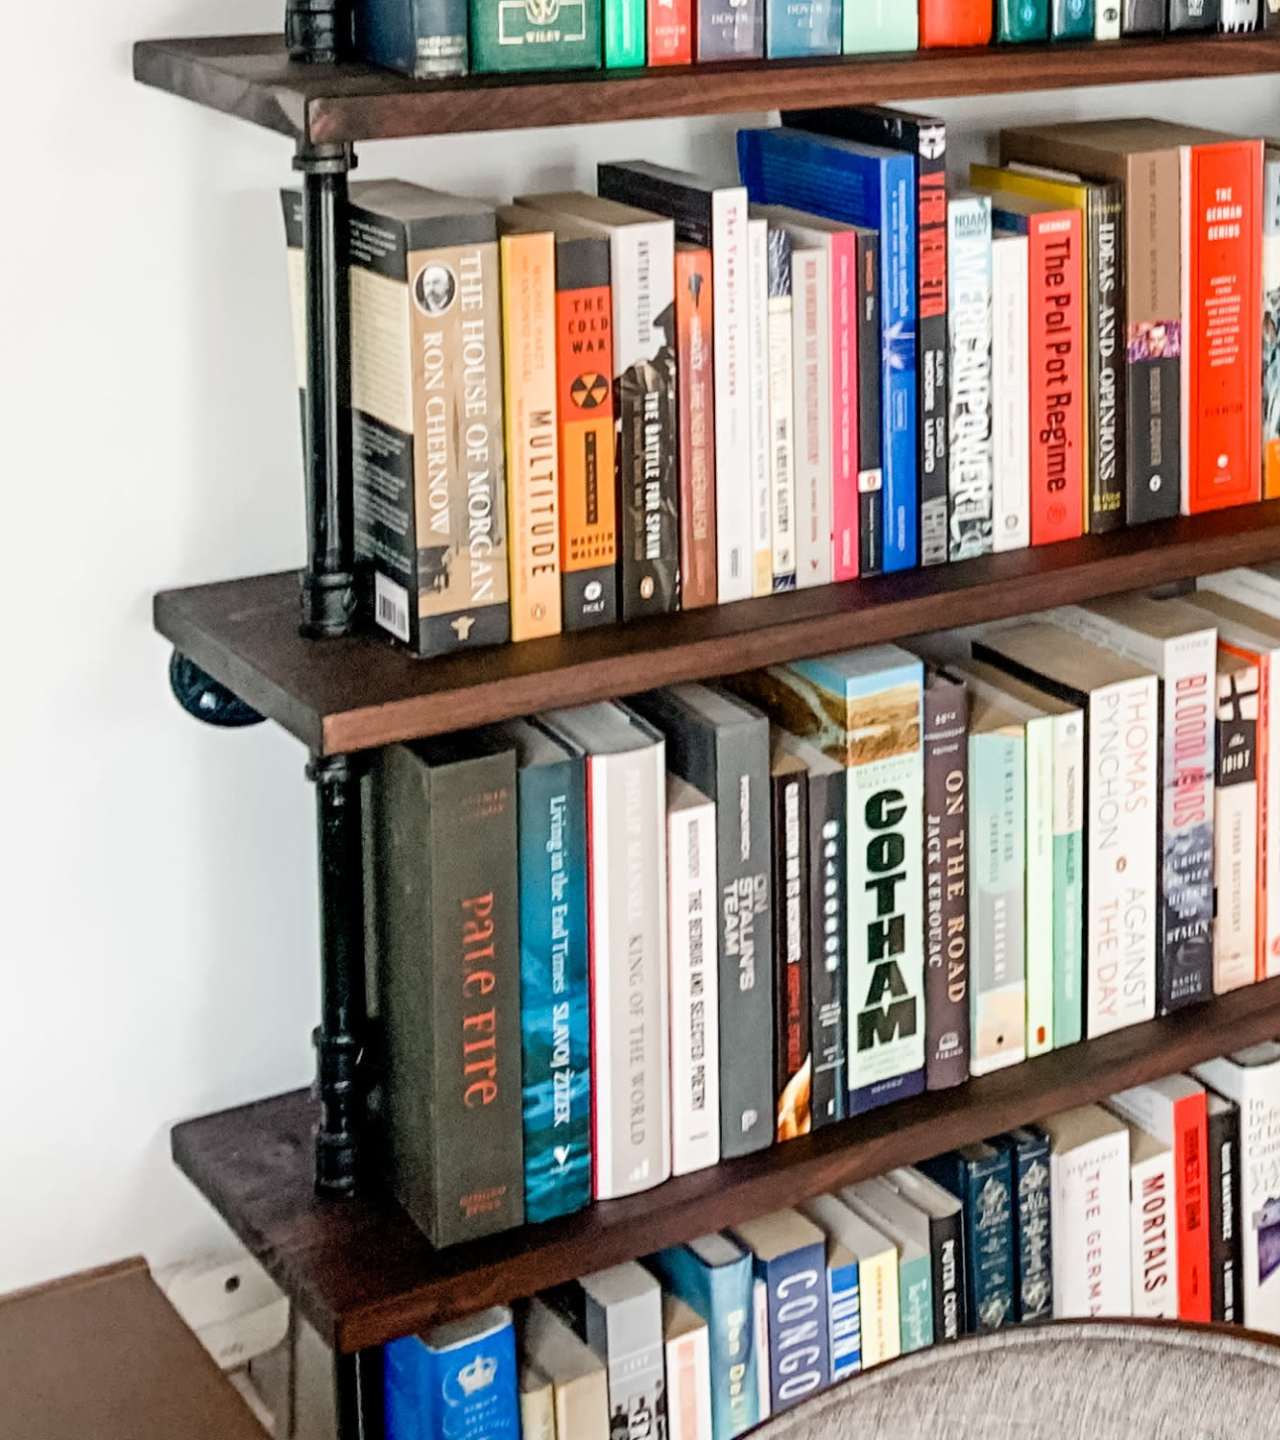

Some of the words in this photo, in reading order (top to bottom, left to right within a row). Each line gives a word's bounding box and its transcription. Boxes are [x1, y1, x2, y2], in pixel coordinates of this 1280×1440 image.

[525, 28, 562, 44] WILEY
[953, 213, 988, 227] NOAM
[1205, 204, 1244, 223] GERMAN
[1215, 186, 1233, 201] THE
[1098, 221, 1115, 294] IDEAS
[1207, 223, 1241, 241] GENIUS
[459, 251, 482, 313] THE
[1044, 238, 1072, 287] The
[567, 318, 611, 335] COLD
[571, 299, 604, 314] THE
[1044, 294, 1072, 335] Pol
[1098, 304, 1116, 357] AND
[423, 332, 446, 388] RON
[461, 319, 487, 419] HOUSE
[571, 338, 607, 353] WAR
[1044, 342, 1072, 388] Pot
[643, 391, 659, 422] THE
[1099, 366, 1117, 481] OPINIONS
[425, 397, 451, 535] CHERNOW
[465, 424, 488, 462] OF
[643, 425, 661, 478] BATTLE
[1041, 395, 1073, 493] Regime
[527, 410, 555, 579] MULTITUDE
[644, 482, 660, 509] FOR
[466, 471, 494, 603] MORGAN
[644, 512, 662, 560] SPAIN
[1098, 691, 1122, 855] PYNCHON
[1124, 686, 1150, 816] THOMAS
[1171, 672, 1208, 831] BLOODLANDS
[1221, 752, 1251, 776] IDIOT
[945, 770, 963, 819] ON
[926, 813, 941, 870] JACK
[946, 830, 965, 904] THE
[724, 881, 738, 956] TEAM
[753, 872, 768, 912] ON
[738, 875, 755, 992] STALIN'S
[856, 787, 918, 1054] GOTHAM
[927, 871, 943, 969] KEROUAC
[1098, 897, 1120, 950] THE
[947, 912, 967, 1004] ROAD
[1124, 886, 1148, 1011] AGAINST
[1097, 954, 1118, 1019] DAY
[1247, 1099, 1265, 1112] In
[1247, 1128, 1262, 1143] of
[1142, 1172, 1168, 1292] MORTALS
[776, 1269, 821, 1401] CONGO
